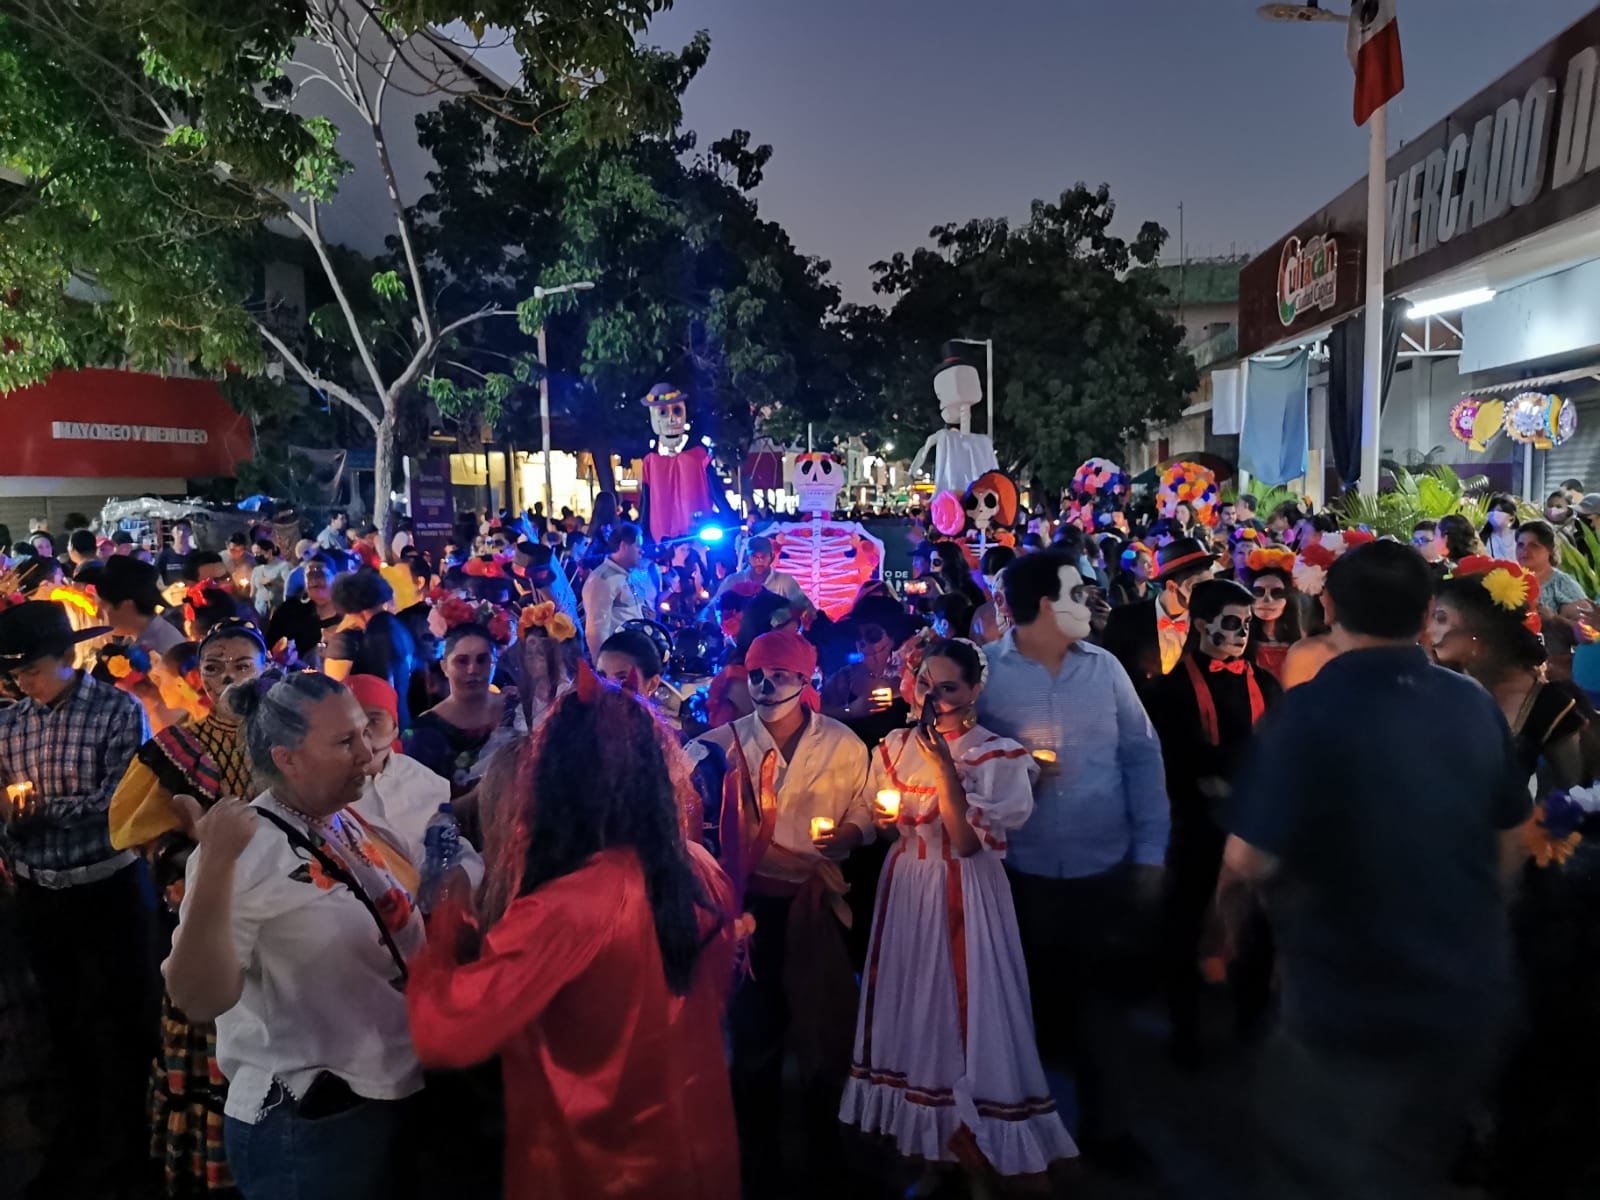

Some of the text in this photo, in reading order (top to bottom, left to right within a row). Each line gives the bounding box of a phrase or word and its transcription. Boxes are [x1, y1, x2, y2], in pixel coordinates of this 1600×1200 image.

[1385, 46, 1600, 271] MERCADO D
[52, 421, 131, 441] MAYOREO
[132, 425, 144, 441] Y
[894, 570, 908, 578] DE
